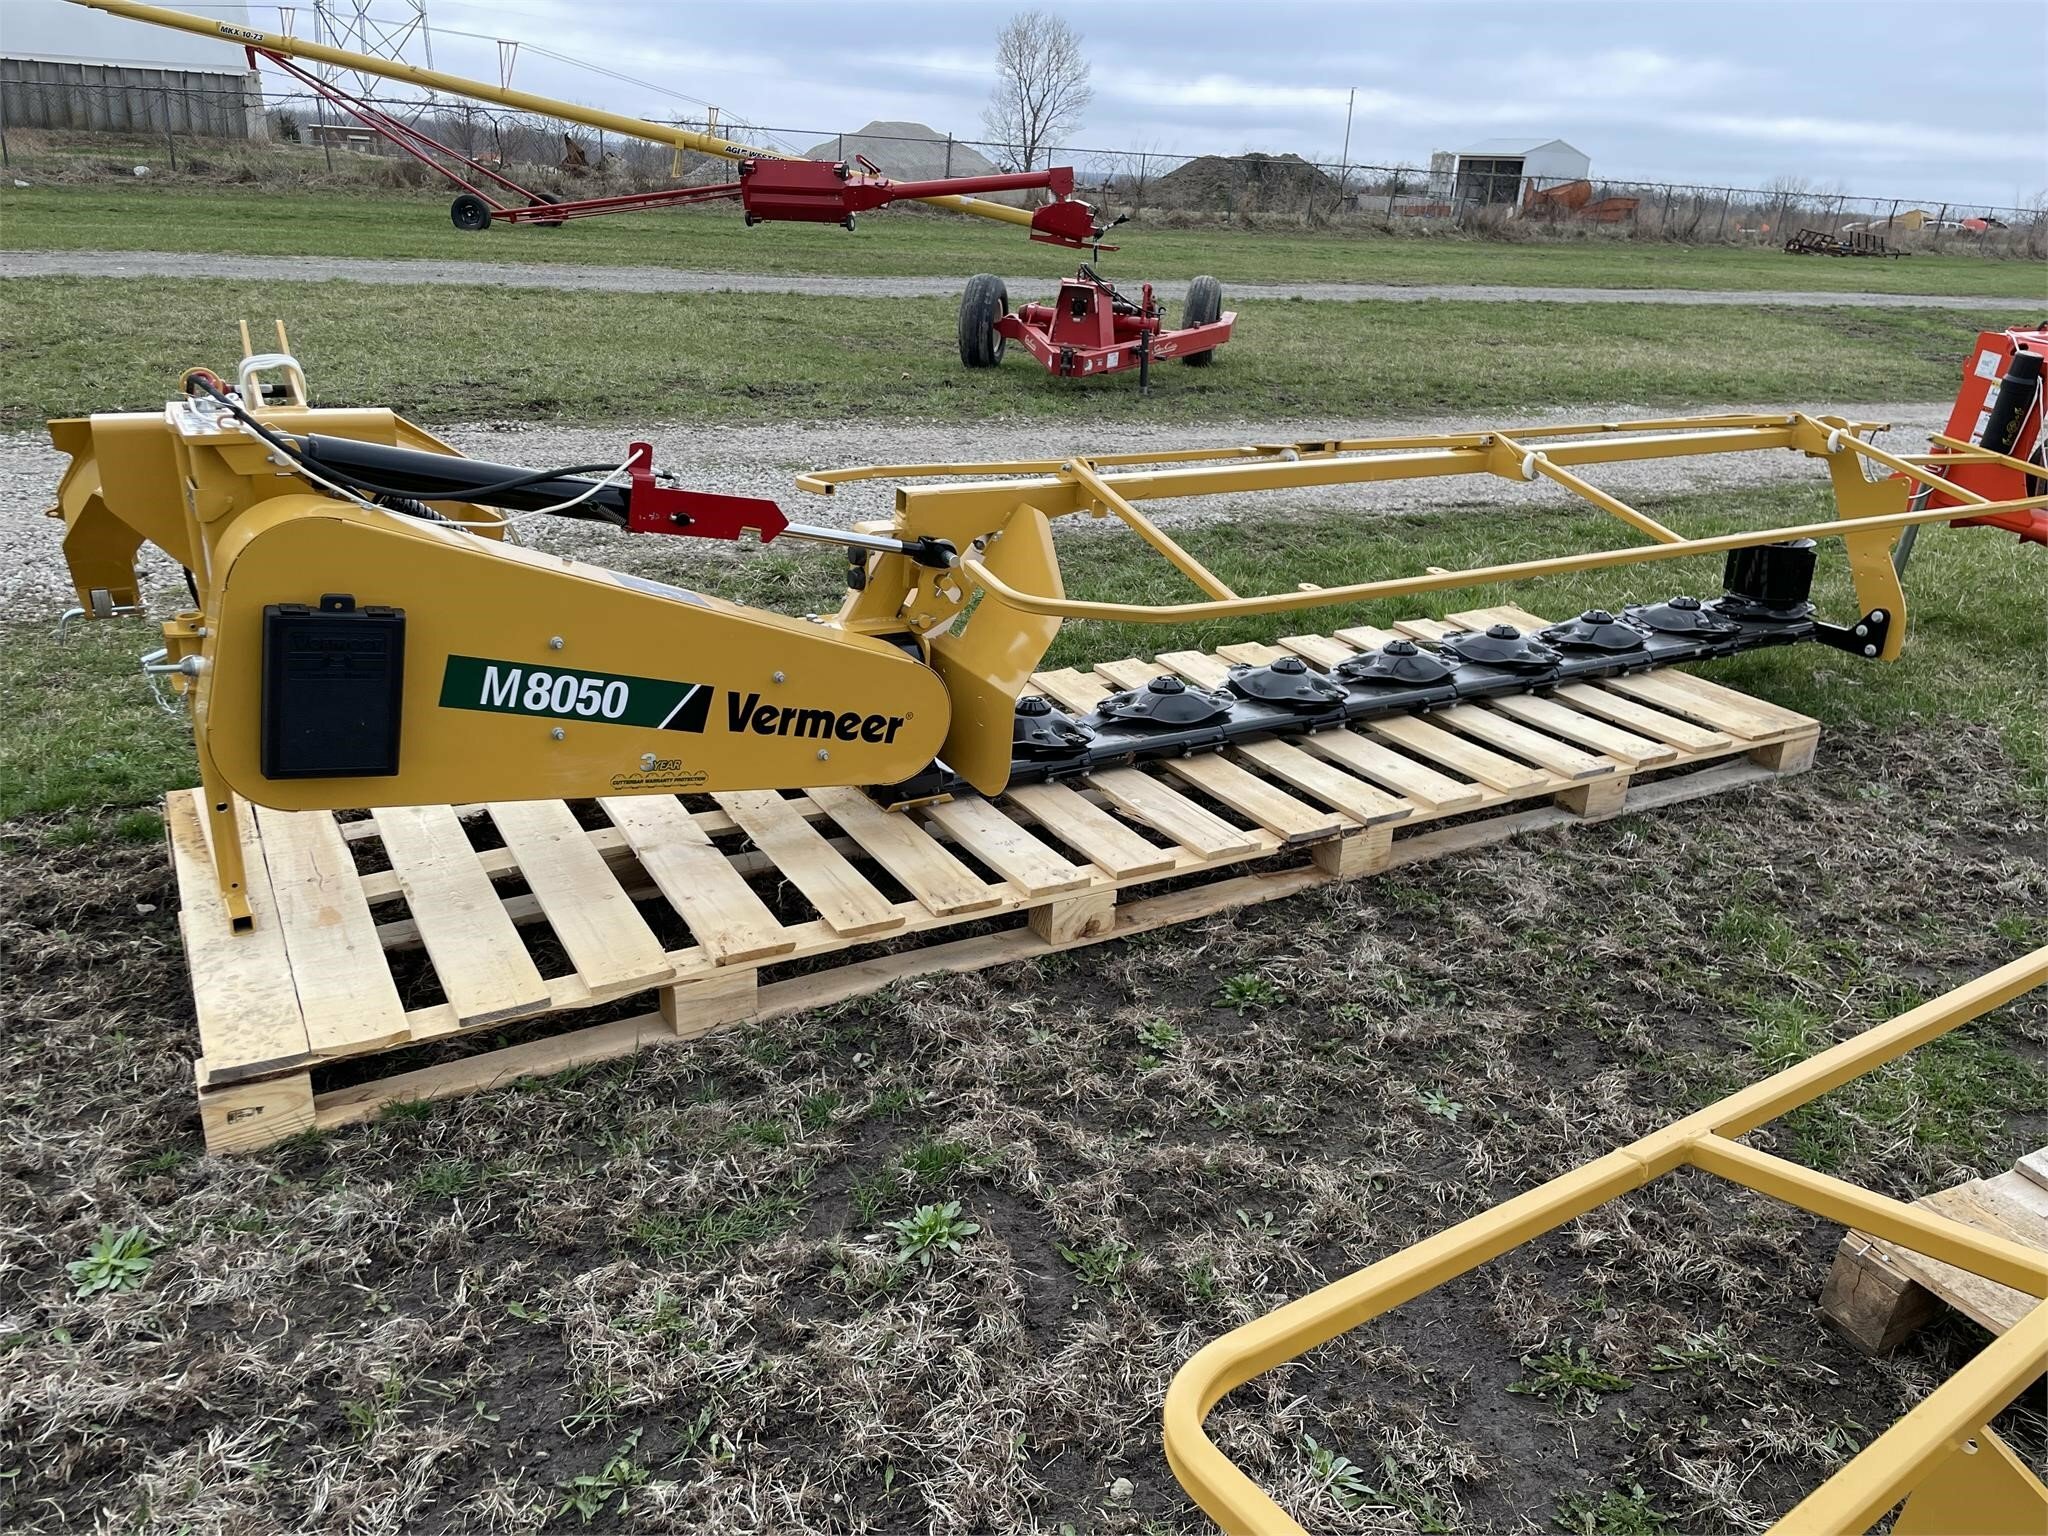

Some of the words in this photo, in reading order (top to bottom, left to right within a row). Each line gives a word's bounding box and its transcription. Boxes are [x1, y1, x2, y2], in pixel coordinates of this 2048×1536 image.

[220, 26, 240, 36] MKX
[242, 31, 264, 41] 10-73
[727, 691, 905, 744] Vermeer
[674, 775, 706, 783] PROTECTION
